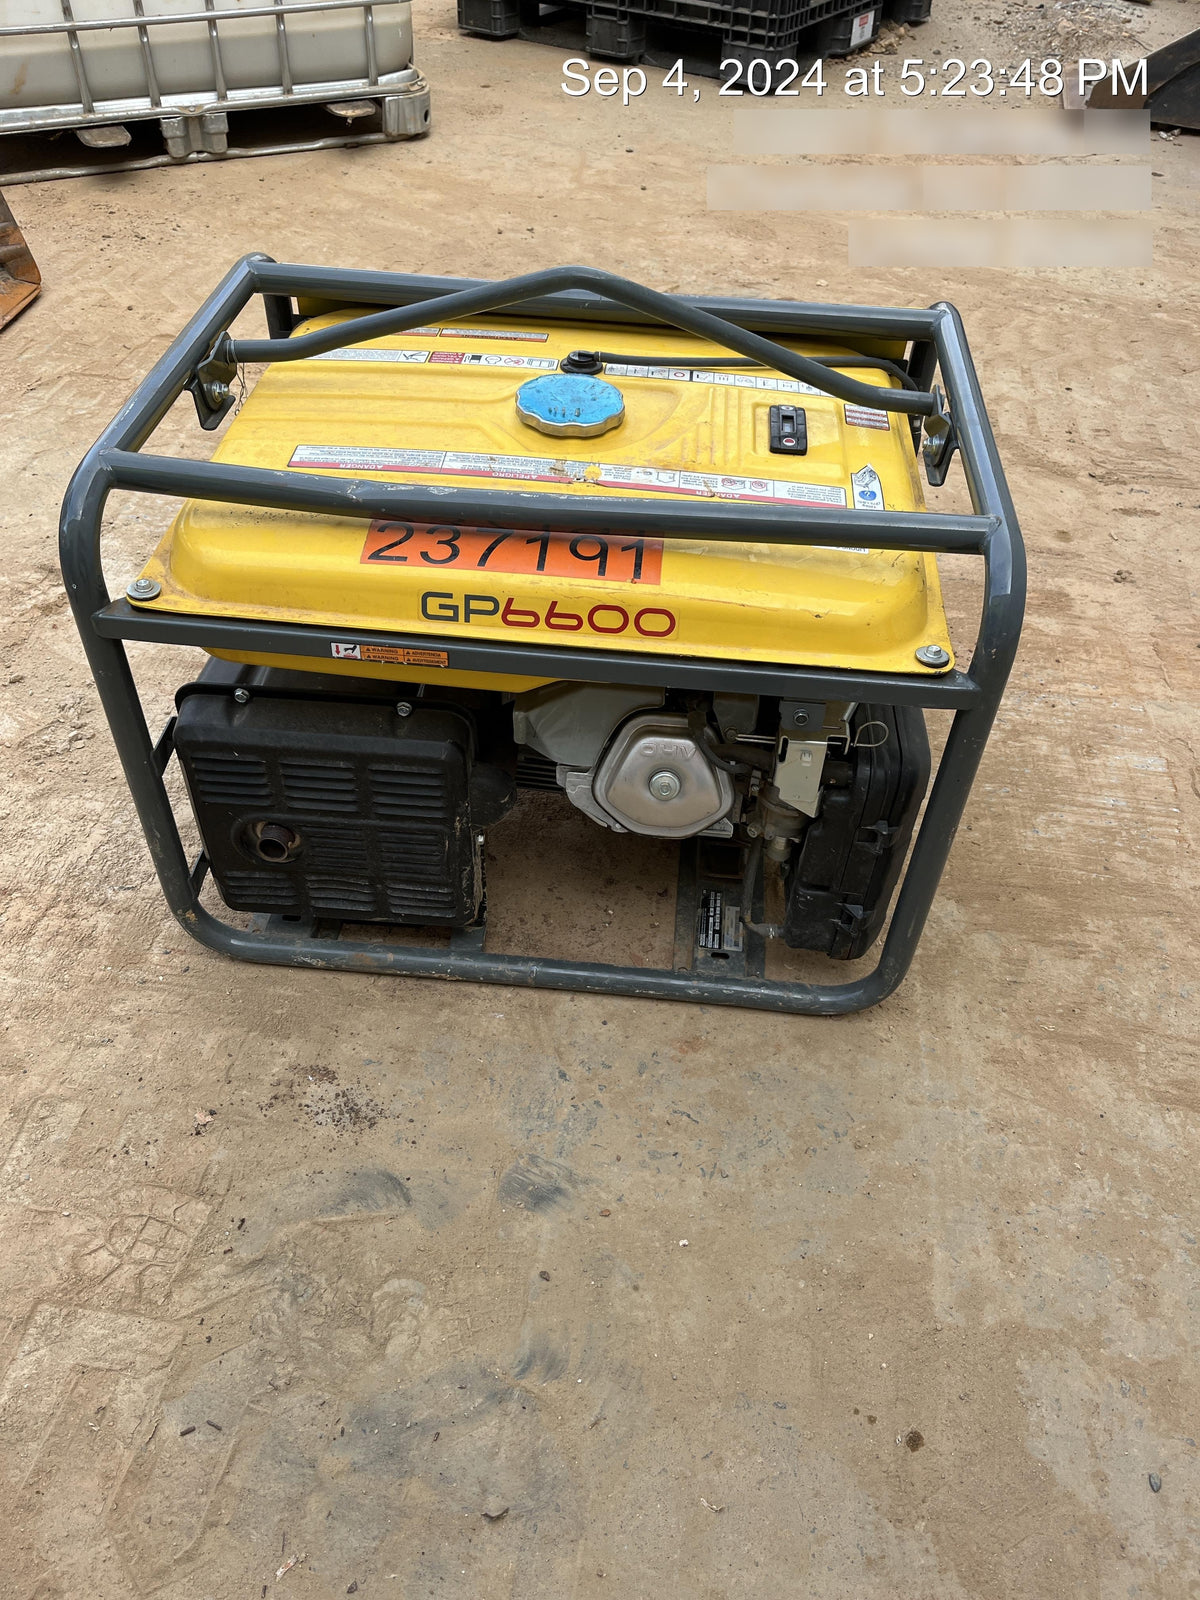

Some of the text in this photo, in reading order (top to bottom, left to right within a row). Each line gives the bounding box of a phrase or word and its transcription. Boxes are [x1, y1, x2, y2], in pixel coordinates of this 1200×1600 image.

[492, 471, 531, 479] PELIGRO
[368, 521, 645, 579] 237191
[421, 591, 676, 637] GP6600
